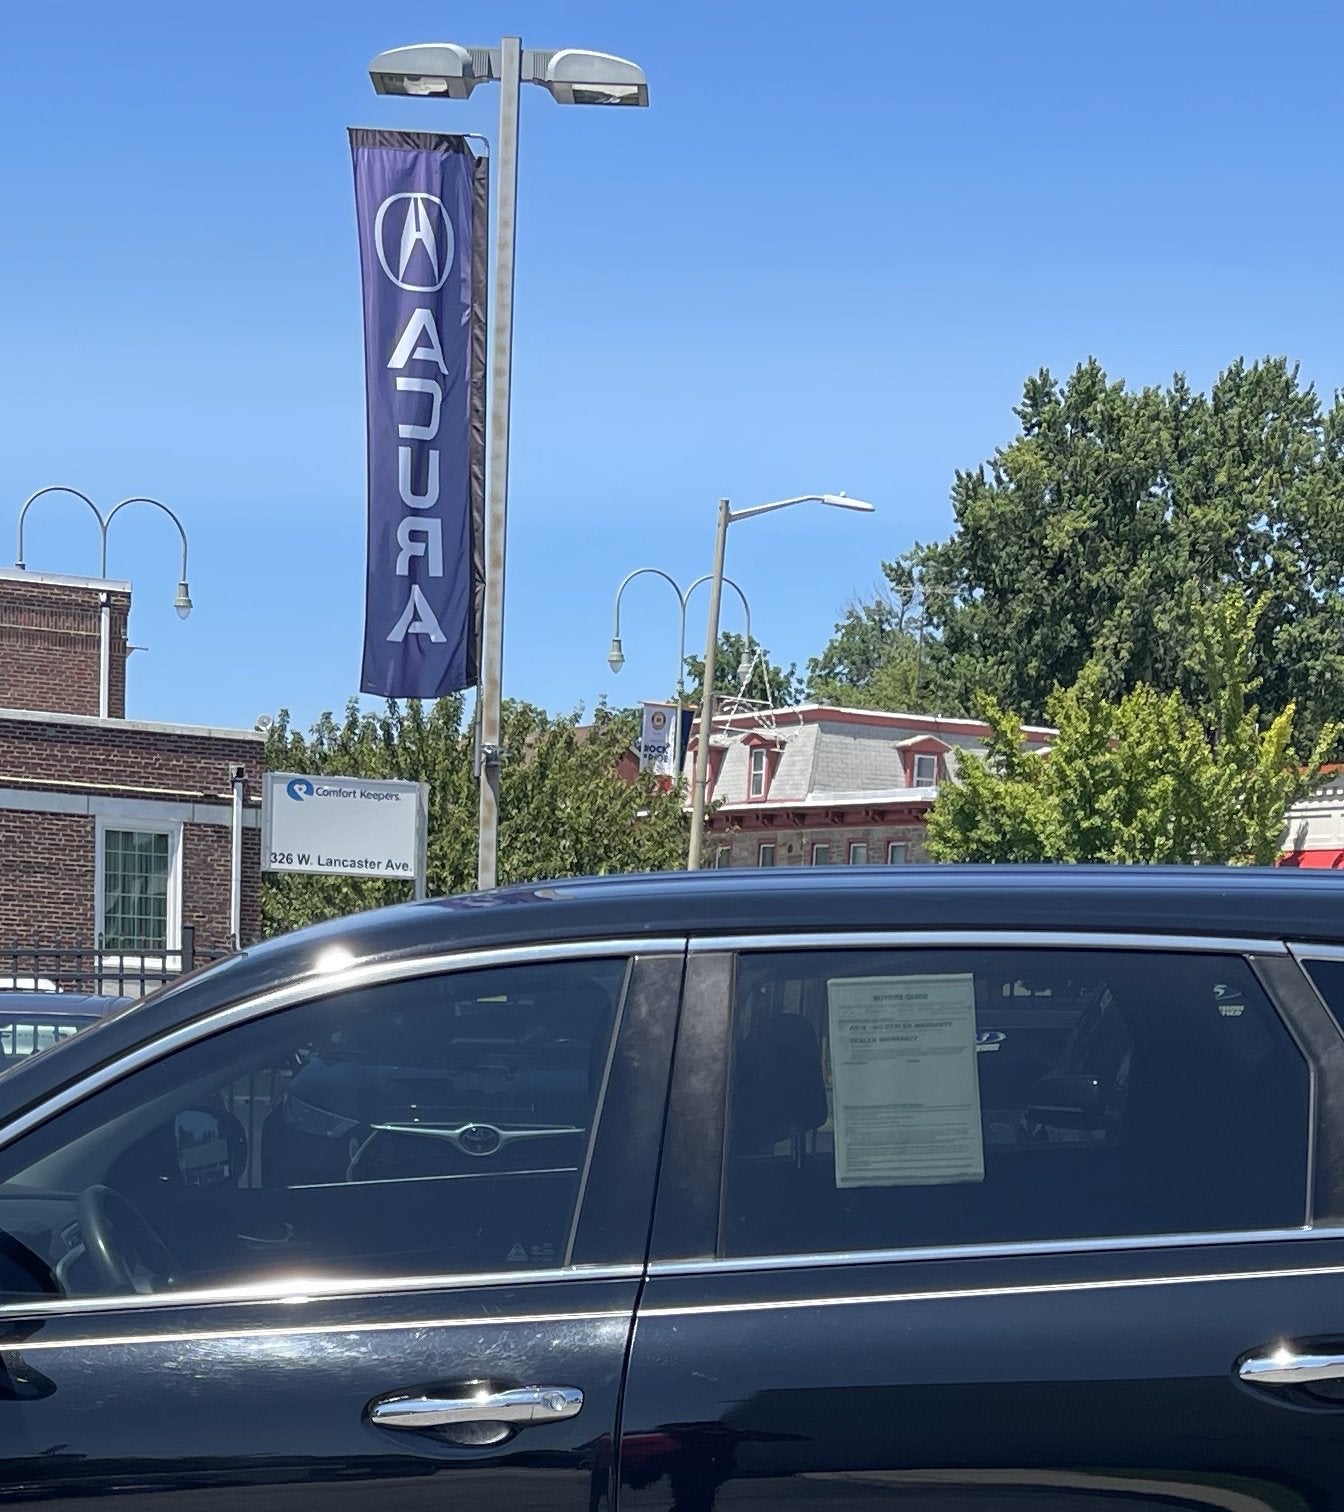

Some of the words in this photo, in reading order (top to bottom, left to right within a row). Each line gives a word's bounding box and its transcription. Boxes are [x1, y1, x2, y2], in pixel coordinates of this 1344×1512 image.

[316, 786, 356, 799] Comfort
[271, 852, 293, 865] 326
[317, 855, 382, 870] Lancaster
